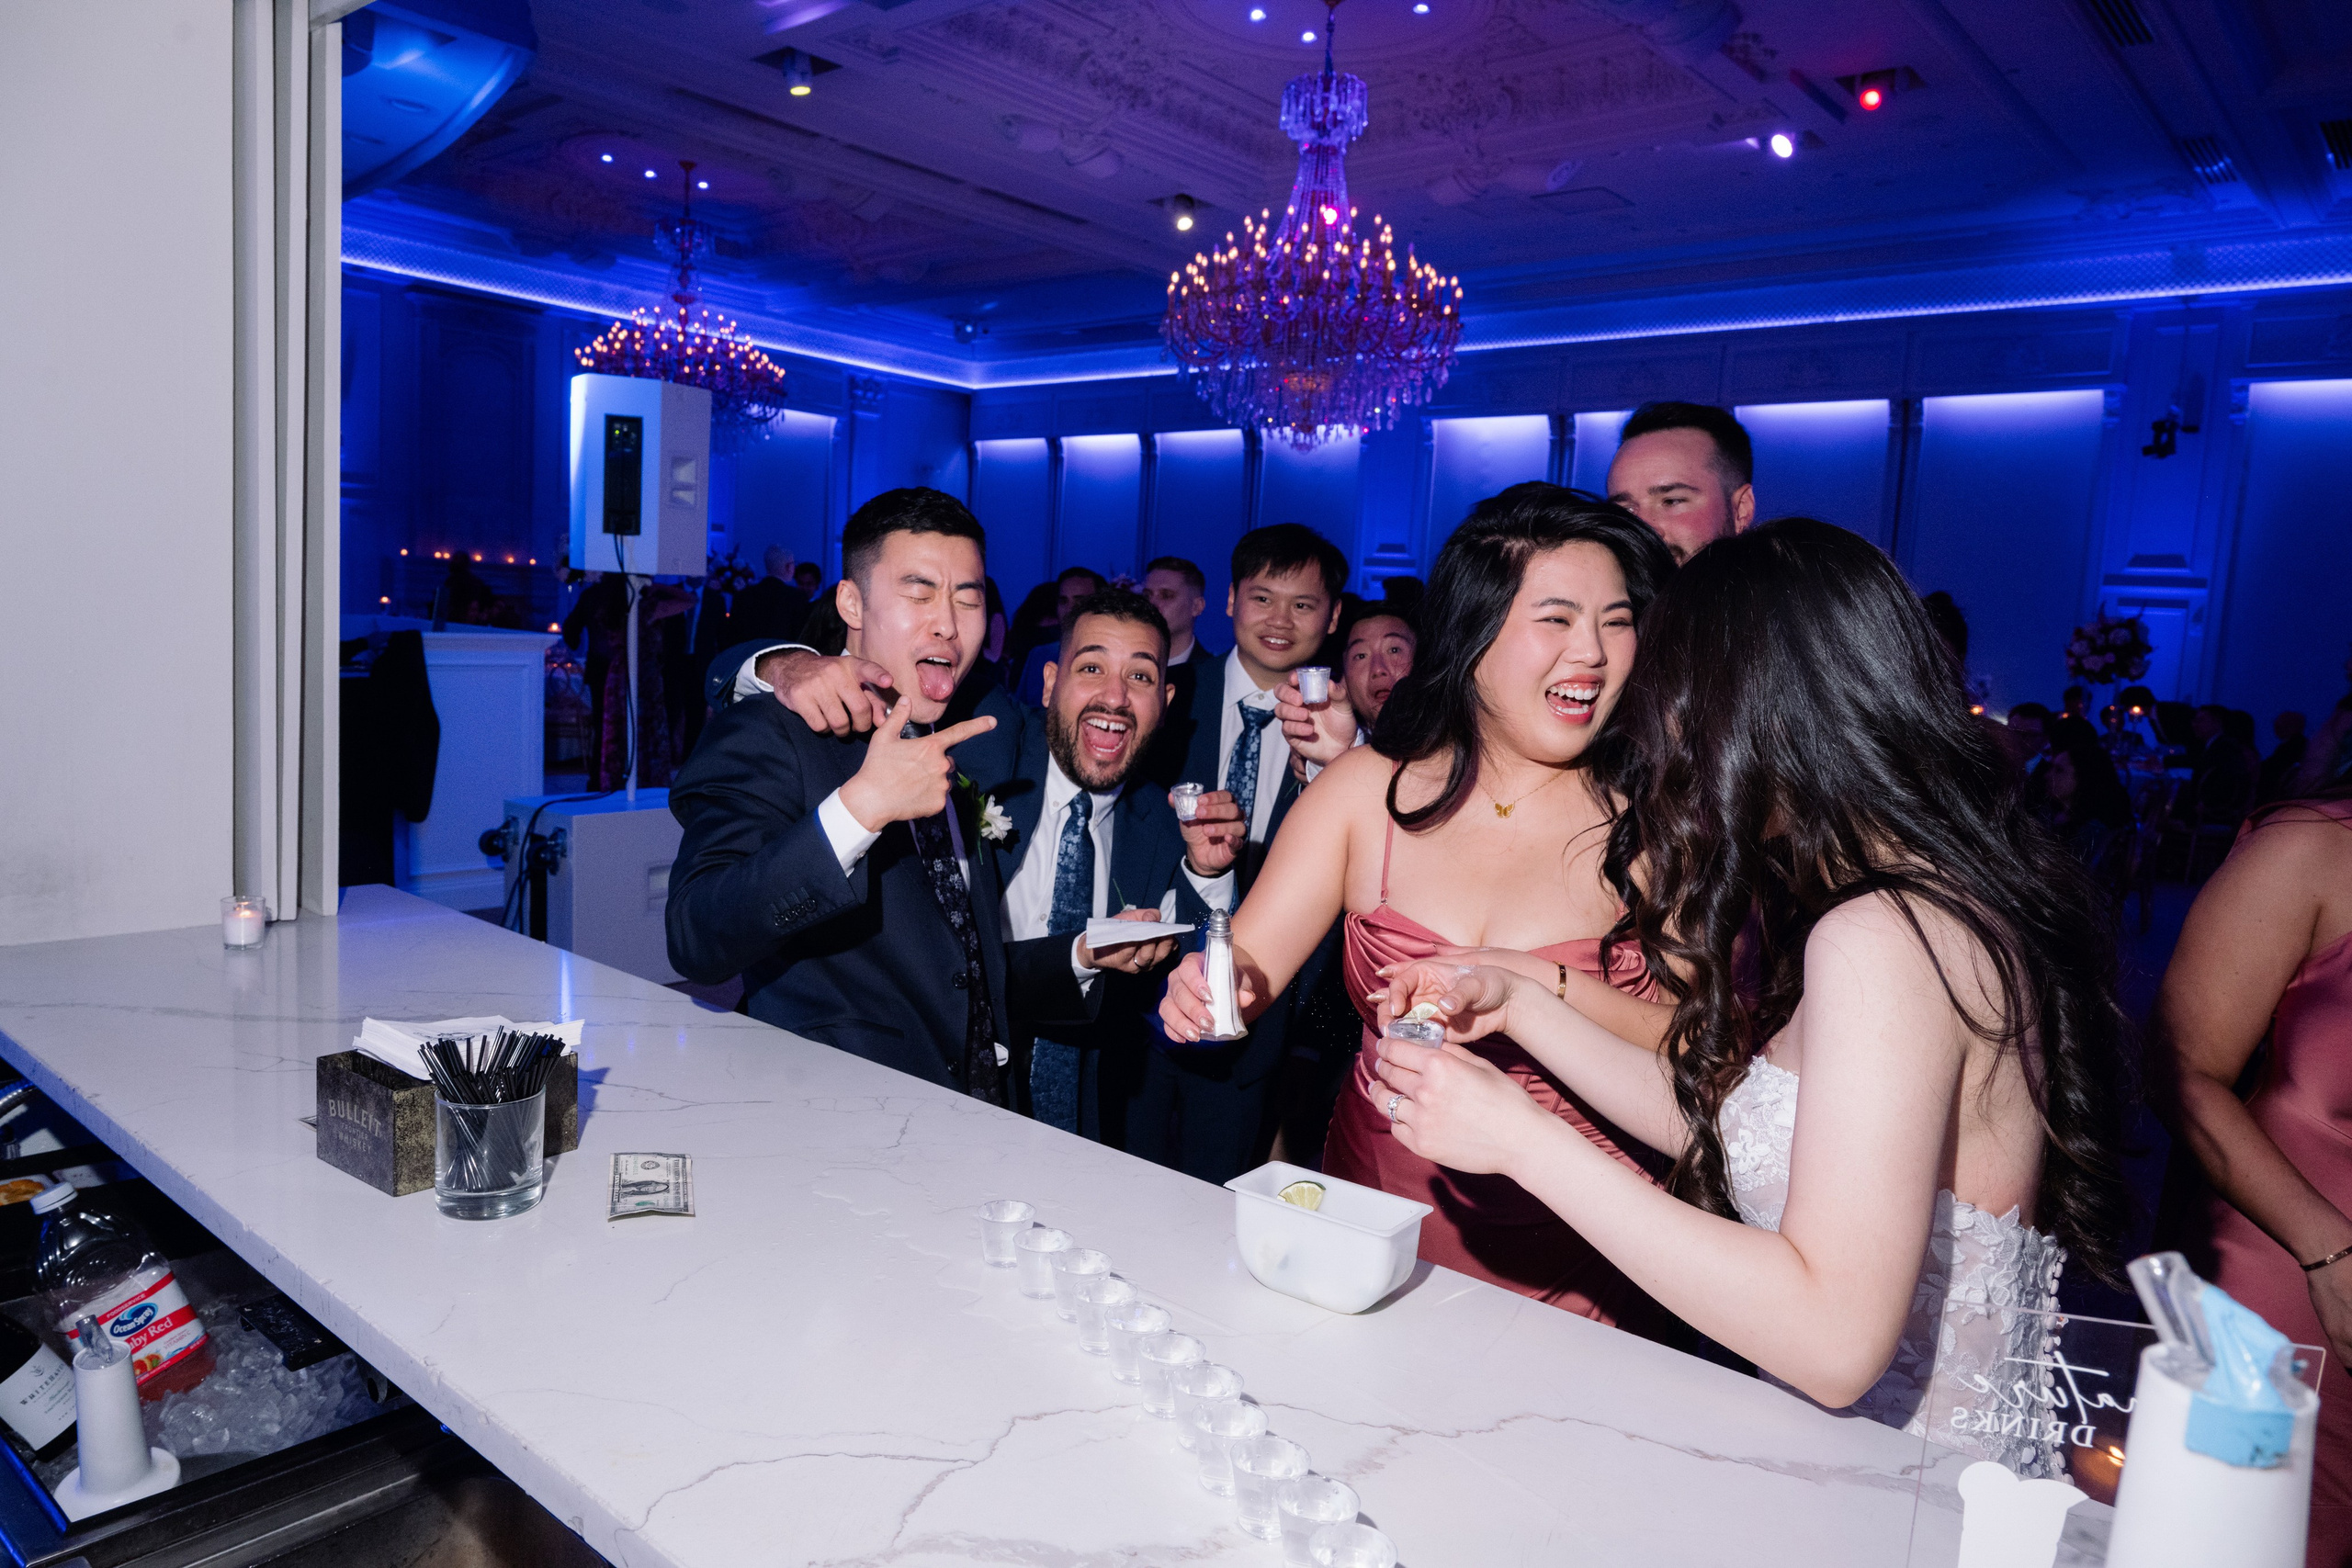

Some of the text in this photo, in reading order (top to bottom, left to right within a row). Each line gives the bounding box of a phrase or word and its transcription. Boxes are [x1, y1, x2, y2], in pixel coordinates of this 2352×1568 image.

[329, 1100, 381, 1137] BULLEIT
[339, 1131, 372, 1155] WHISKEY
[107, 1293, 146, 1318] FOODSERVICE
[113, 1307, 154, 1334] Ocean Spray
[130, 1333, 148, 1349] uby
[148, 1317, 174, 1337] Red
